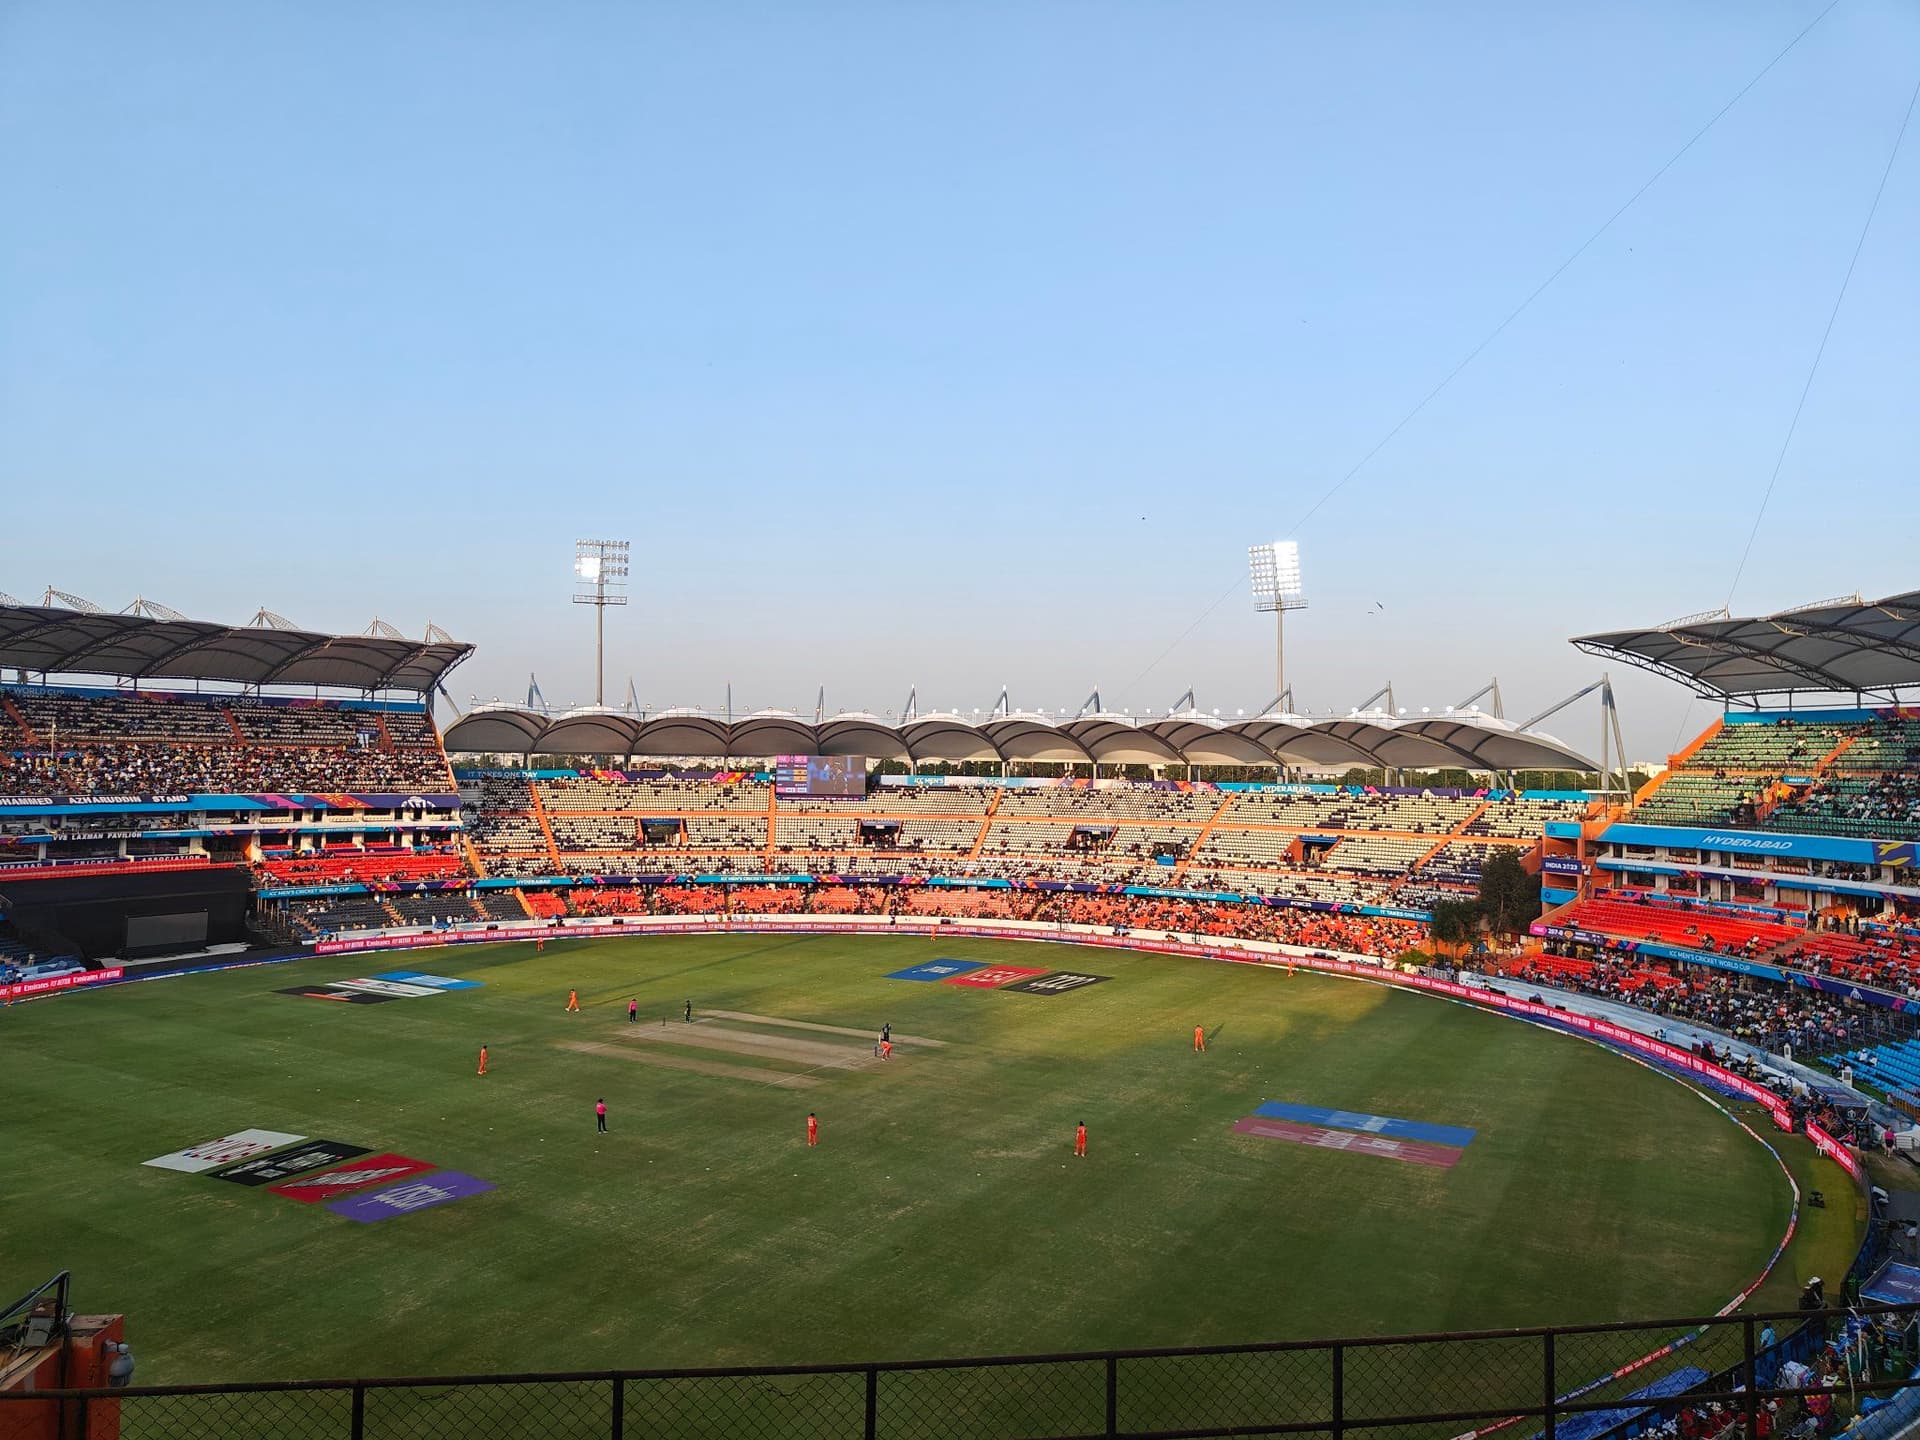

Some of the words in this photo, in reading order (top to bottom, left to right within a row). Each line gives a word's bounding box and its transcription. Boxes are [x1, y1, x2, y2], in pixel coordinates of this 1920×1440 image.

[68, 796, 141, 804] AZHARUDDIN
[1702, 835, 1792, 850] HYDERABAD
[1678, 952, 1694, 960] MEN'S
[1695, 955, 1717, 964] CRICKET
[1720, 960, 1738, 969] WORLD
[73, 975, 98, 983] Emirates
[24, 983, 48, 992] Emirates
